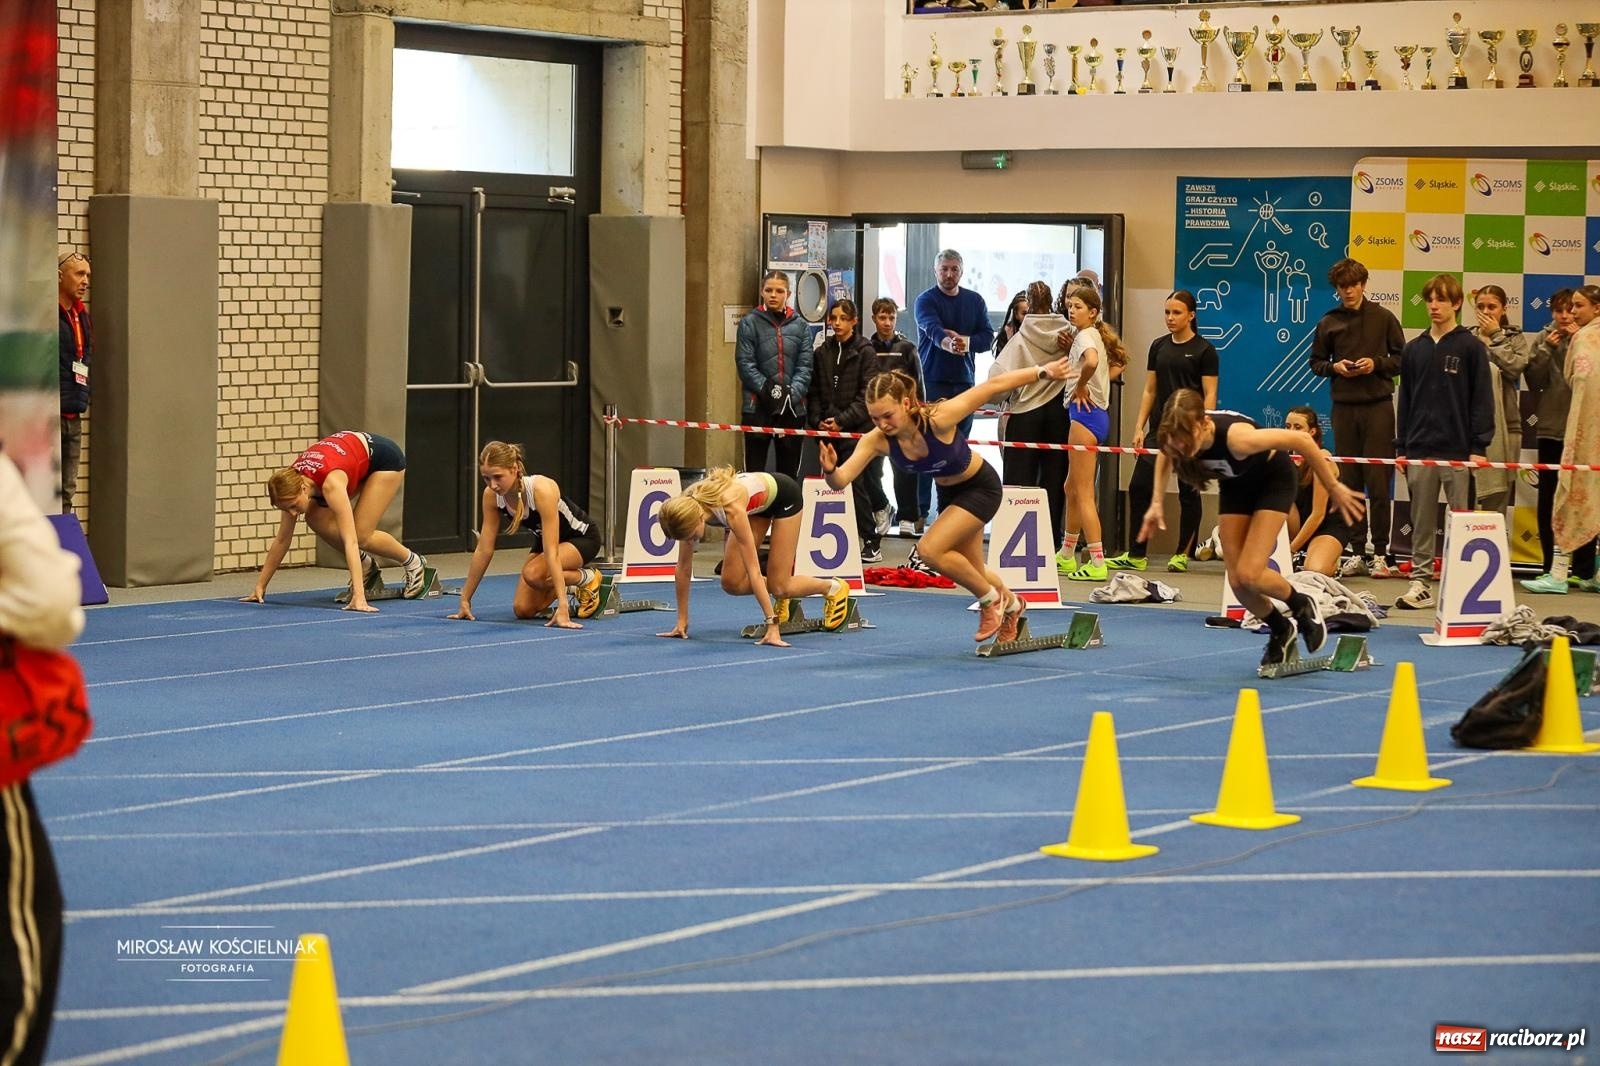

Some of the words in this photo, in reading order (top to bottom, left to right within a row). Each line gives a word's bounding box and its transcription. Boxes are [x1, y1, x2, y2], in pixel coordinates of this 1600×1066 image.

[1376, 178, 1404, 186] ZSOMS
[1493, 180, 1522, 188] ZSOMS
[1431, 236, 1461, 245] ZSOMS
[1552, 239, 1582, 248] ZSOMS
[1370, 292, 1400, 301] ZSOMS
[649, 478, 673, 486] polanik
[1014, 498, 1041, 506] polanik
[638, 490, 676, 556] 6
[809, 501, 849, 570] 5
[999, 511, 1046, 581] 4
[1459, 537, 1502, 614] 2
